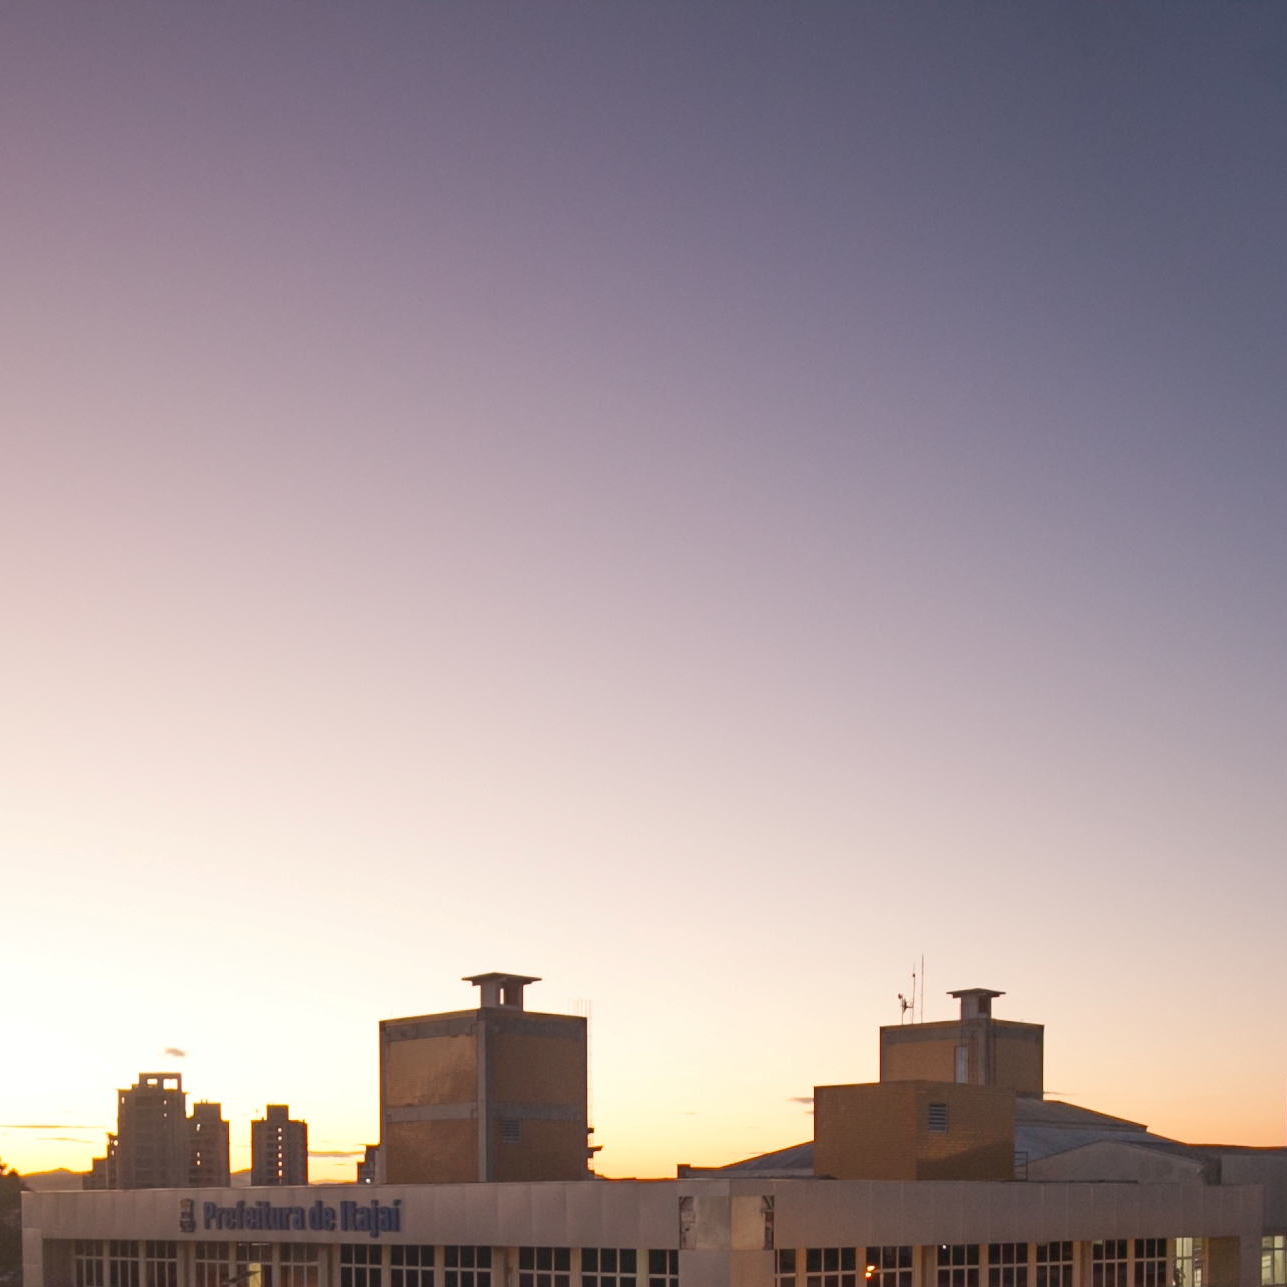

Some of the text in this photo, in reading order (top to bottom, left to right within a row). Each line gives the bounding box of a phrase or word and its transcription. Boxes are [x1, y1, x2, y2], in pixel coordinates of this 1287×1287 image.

[204, 1199, 401, 1238] Prefeitura de Itajaí
